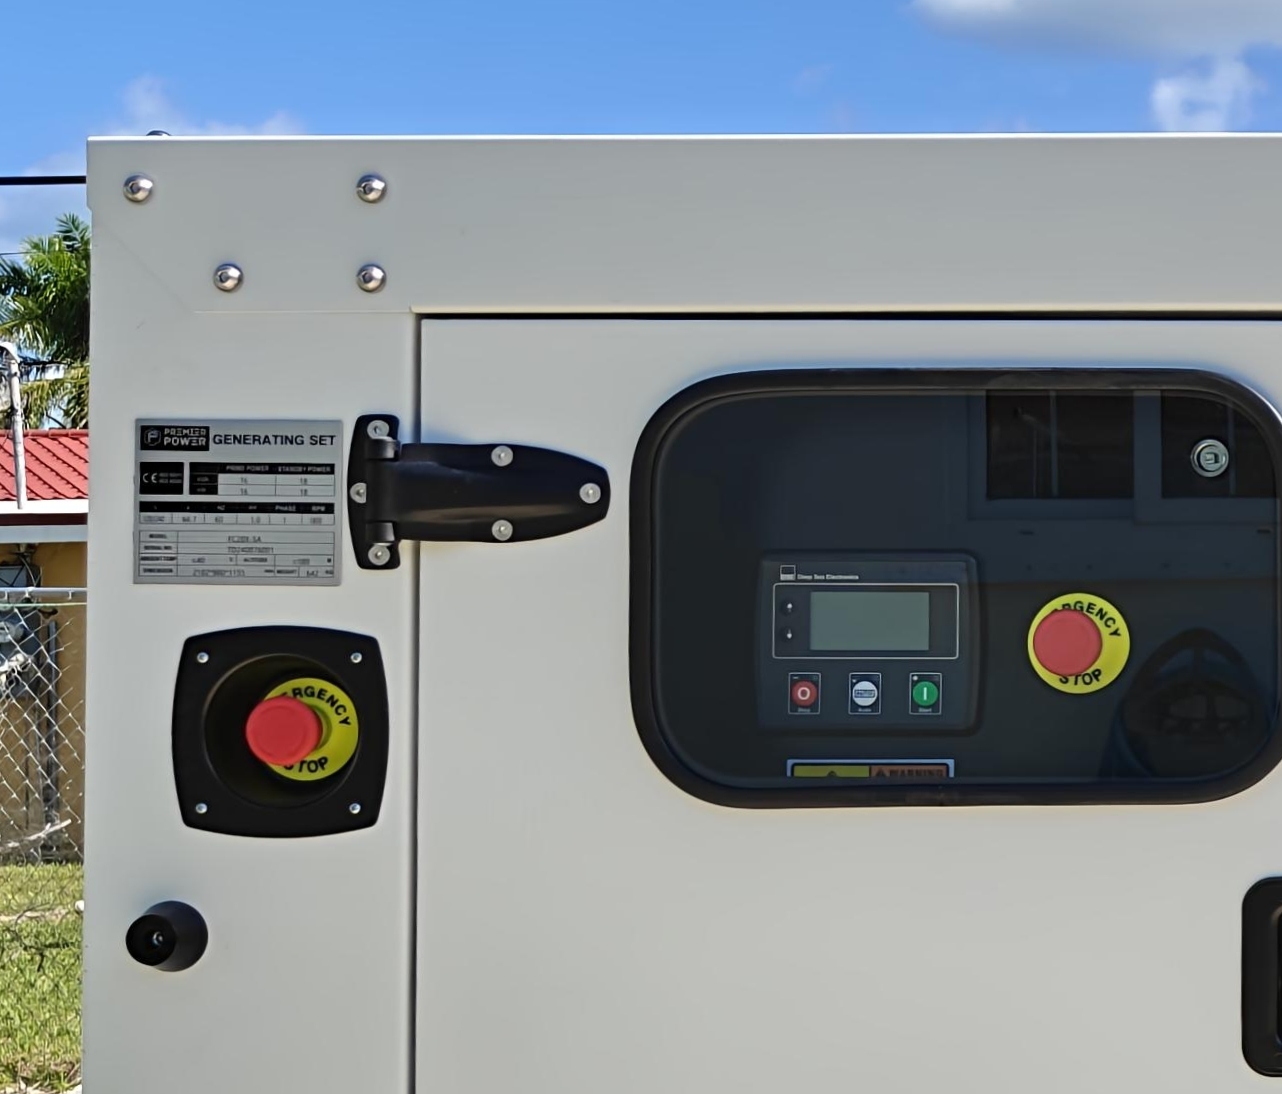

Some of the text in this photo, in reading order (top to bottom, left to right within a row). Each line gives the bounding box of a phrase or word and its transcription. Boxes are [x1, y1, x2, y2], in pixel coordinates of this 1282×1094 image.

[163, 428, 207, 436] PREMIER
[163, 437, 207, 446] POWER
[212, 434, 337, 446] GENERATING SET
